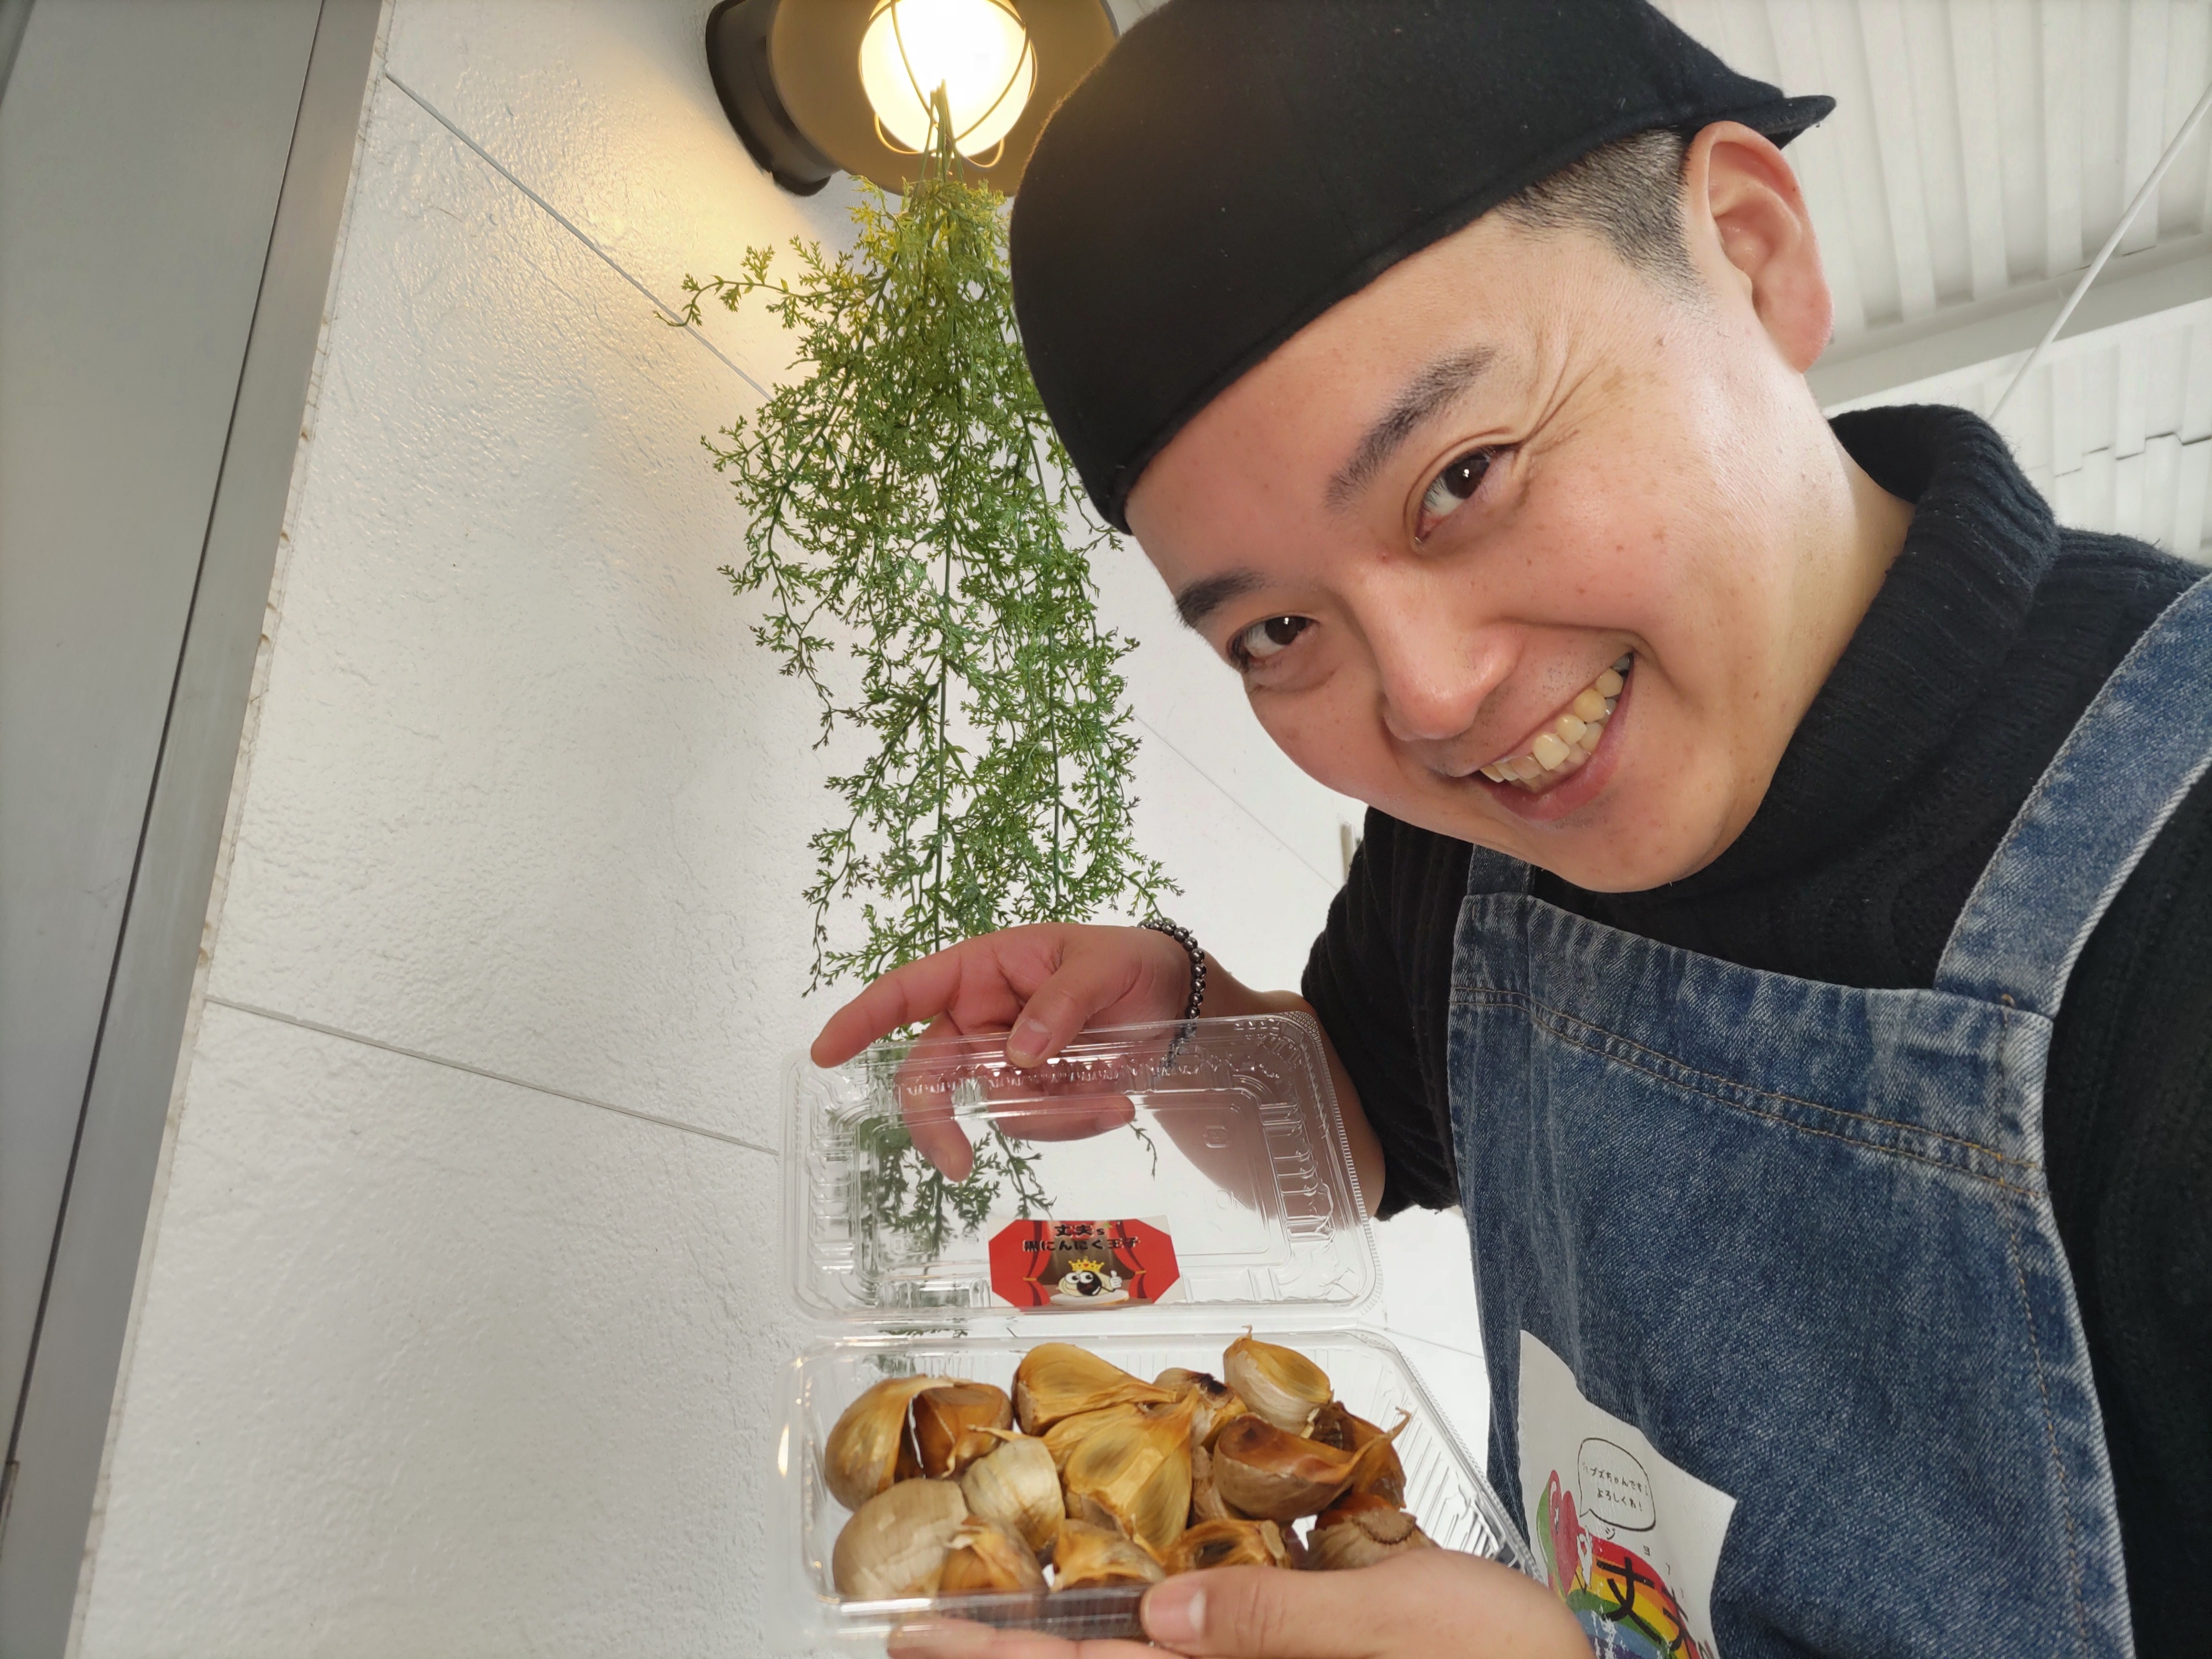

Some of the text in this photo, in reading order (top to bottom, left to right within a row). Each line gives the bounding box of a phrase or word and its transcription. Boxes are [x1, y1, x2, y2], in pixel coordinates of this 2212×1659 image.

[1022, 1236, 1141, 1252] 黒にんにく王子
